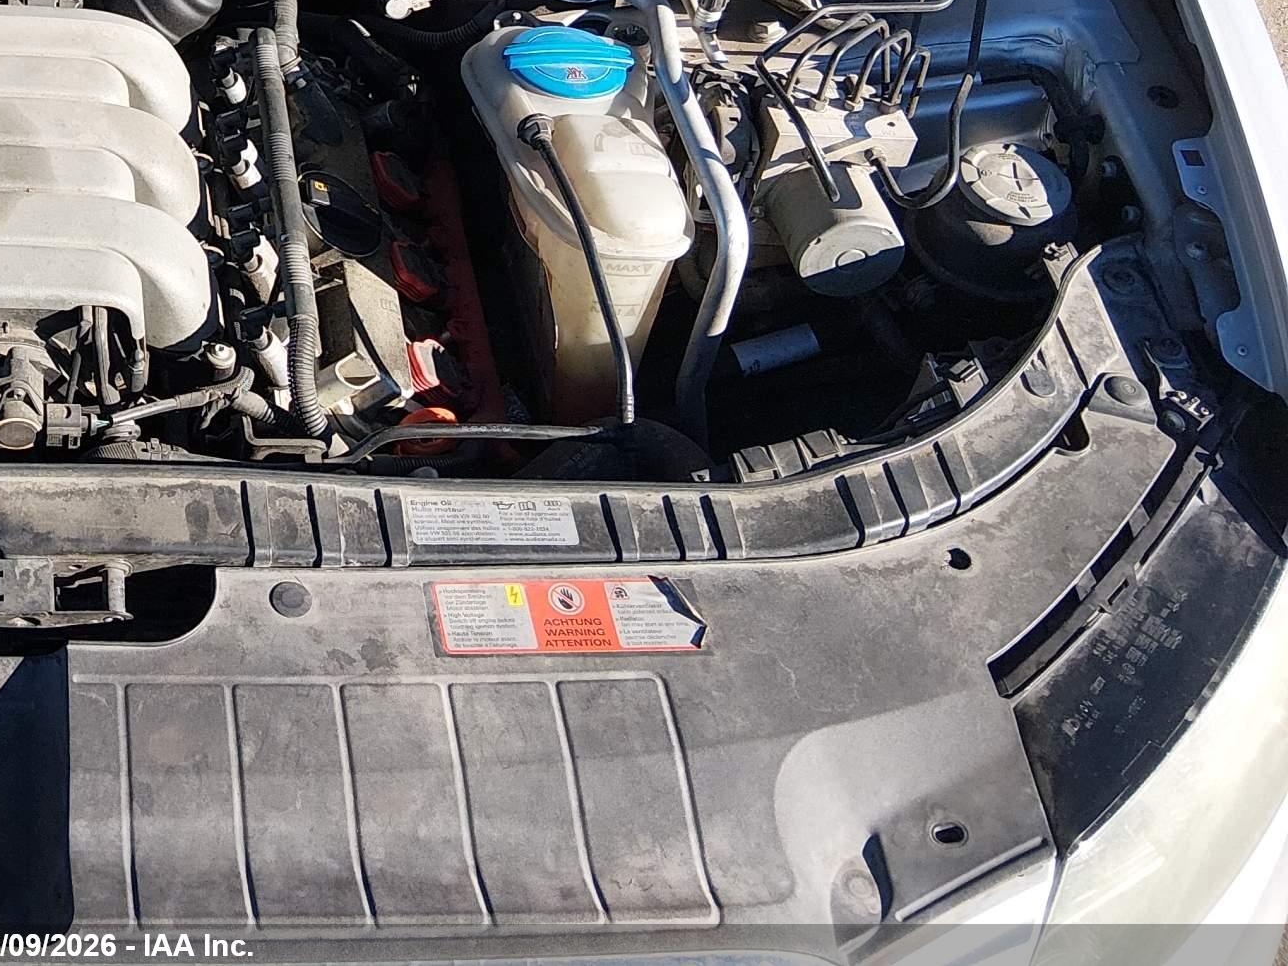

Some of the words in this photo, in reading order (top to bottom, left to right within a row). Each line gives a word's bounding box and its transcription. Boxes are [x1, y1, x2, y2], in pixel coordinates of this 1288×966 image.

[605, 263, 641, 273] MAX
[543, 617, 602, 626] ACHTUNG
[544, 628, 605, 637] WARNING
[545, 638, 612, 647] ATTENTION
